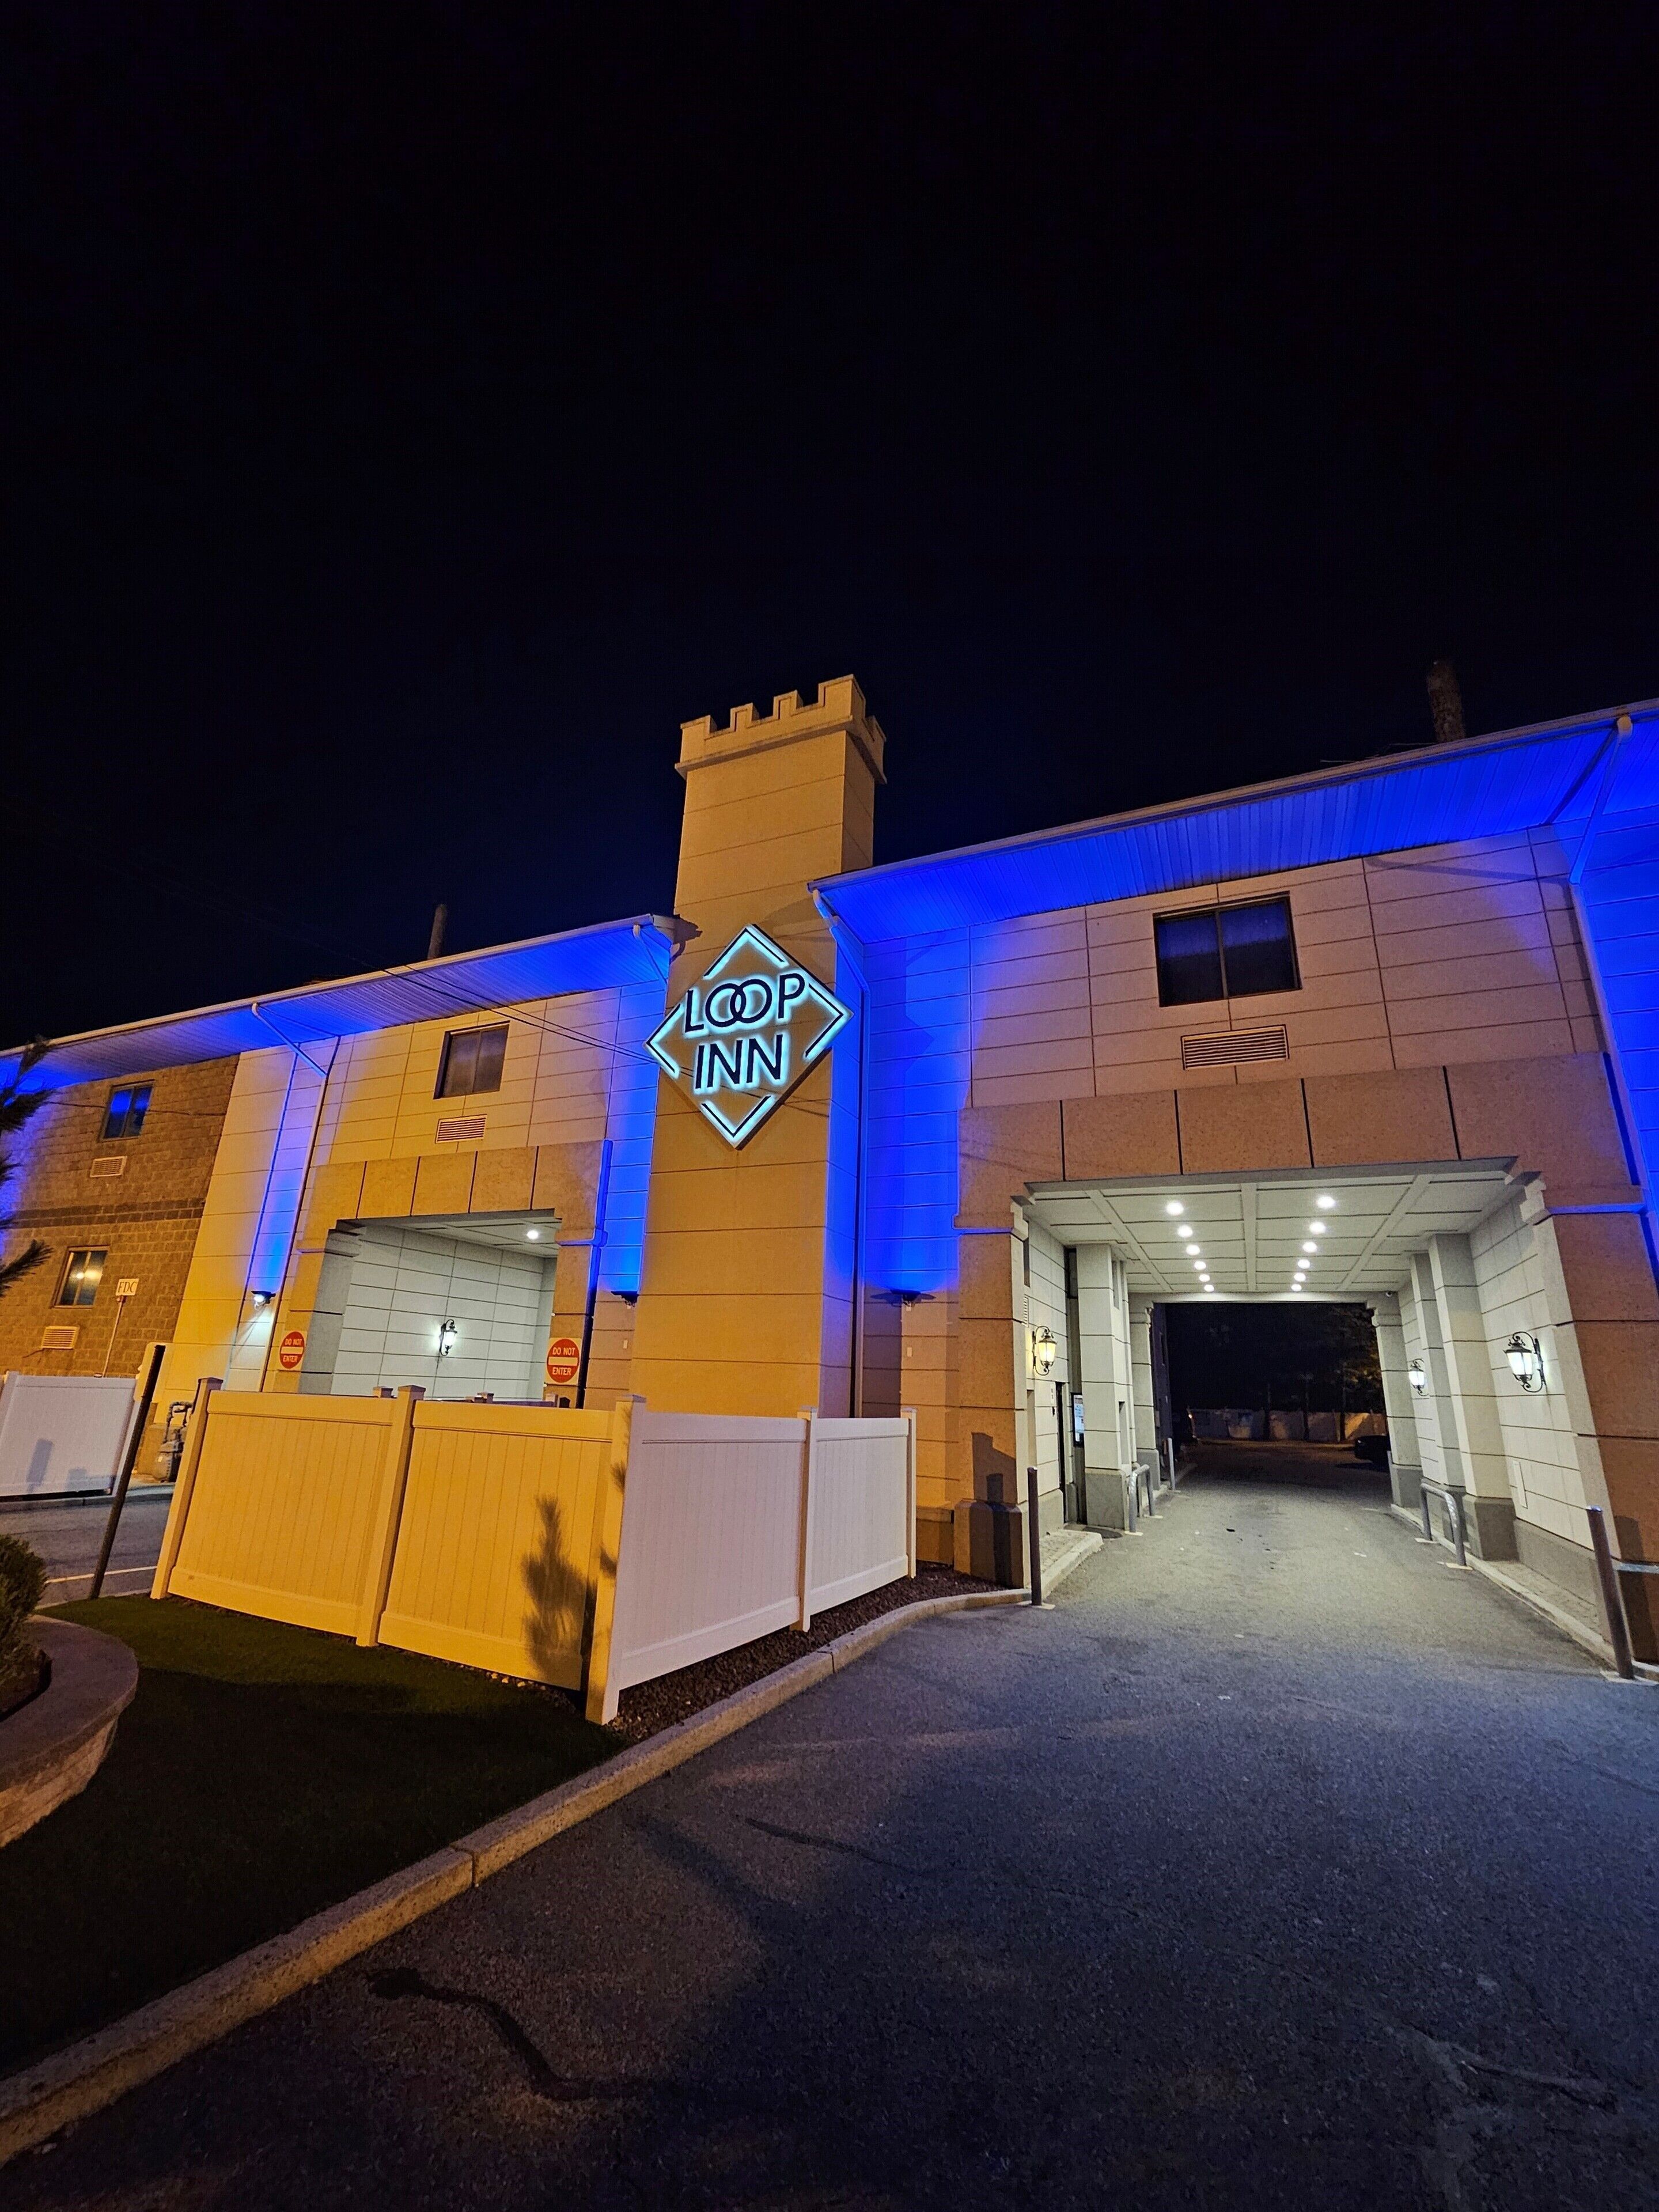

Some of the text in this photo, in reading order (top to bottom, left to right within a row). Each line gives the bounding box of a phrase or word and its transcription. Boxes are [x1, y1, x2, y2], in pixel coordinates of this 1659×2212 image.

[684, 972, 806, 1033] LOOP
[695, 1034, 783, 1089] INN
[118, 1281, 138, 1293] FDC
[552, 1347, 575, 1355] DO NOT
[552, 1366, 572, 1376] ENTER
